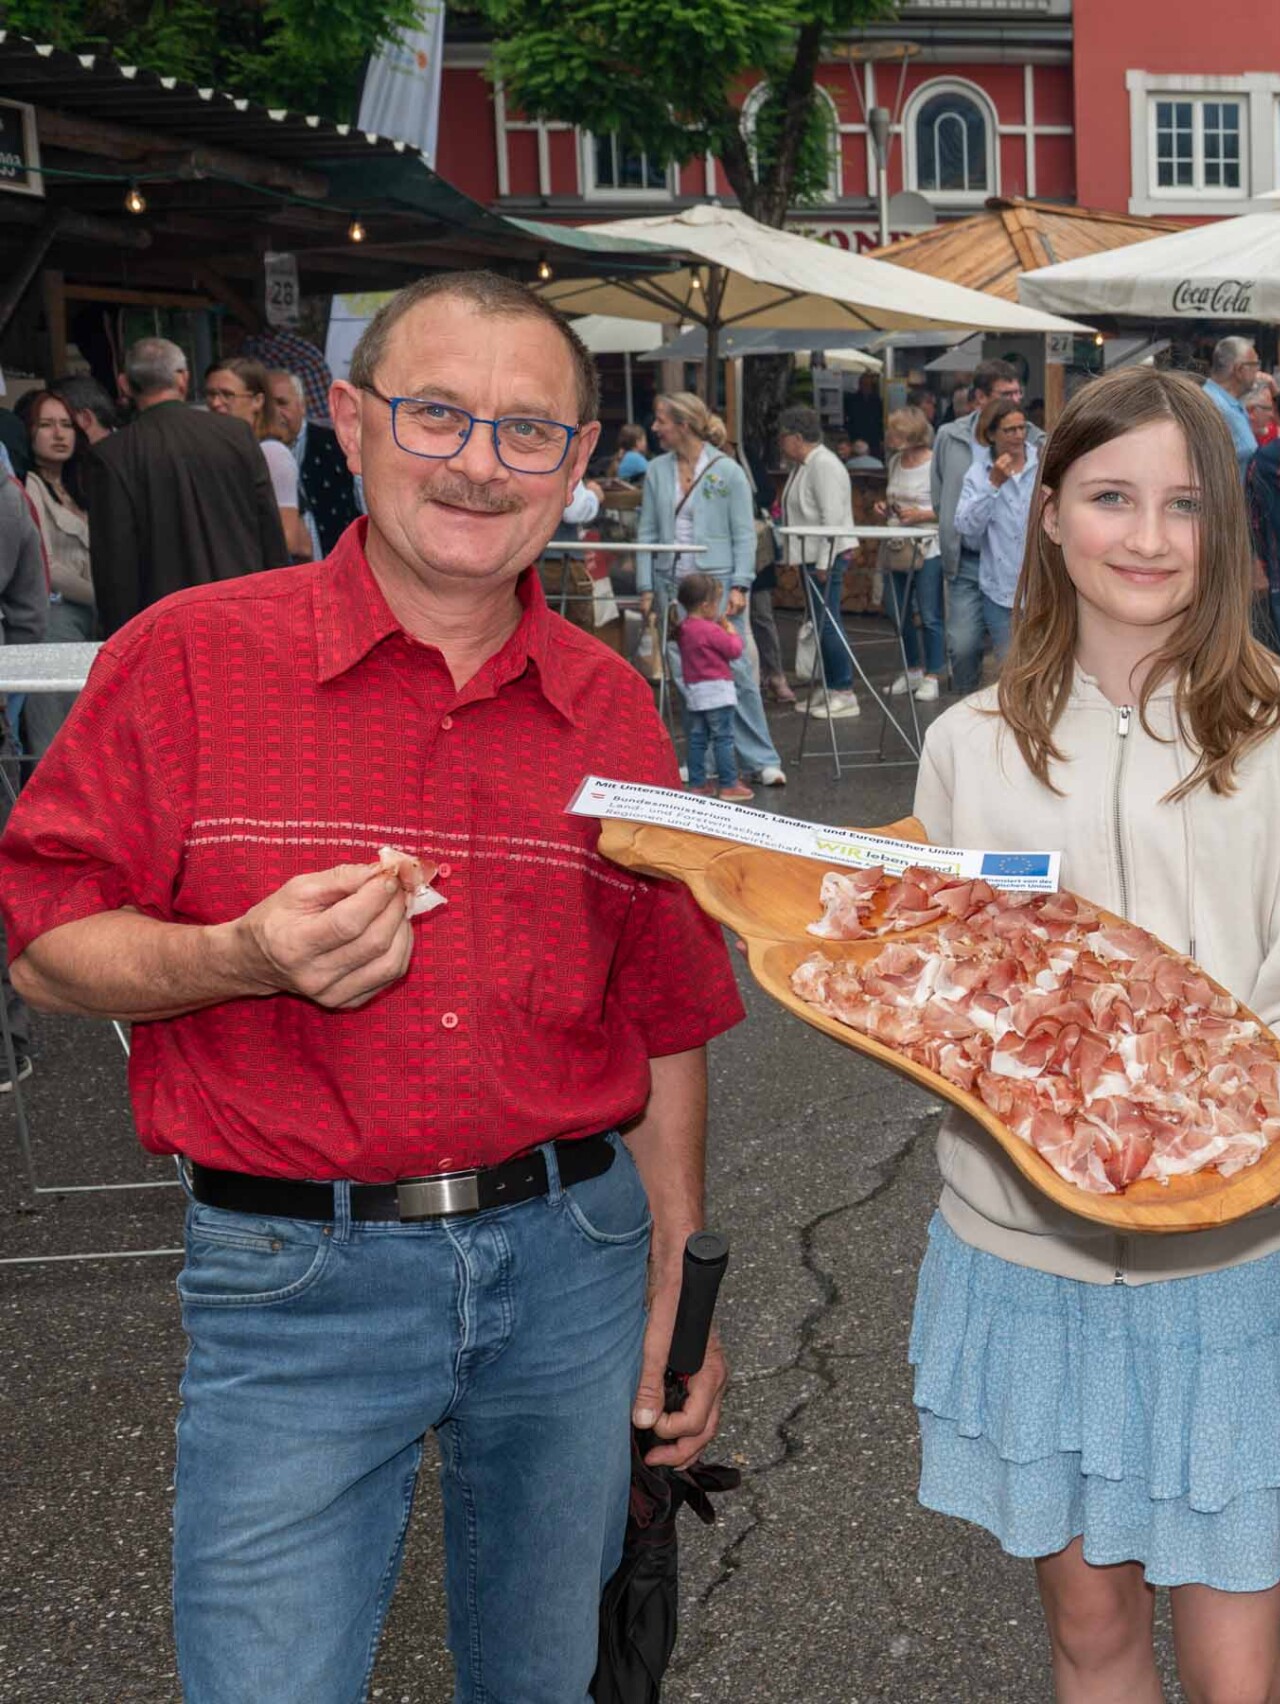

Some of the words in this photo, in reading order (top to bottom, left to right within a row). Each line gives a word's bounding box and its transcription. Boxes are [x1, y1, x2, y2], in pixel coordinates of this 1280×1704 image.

[271, 281, 294, 306] 28
[1172, 279, 1254, 313] Coca-Cola
[1051, 336, 1069, 351] 27
[595, 781, 616, 789] Mit
[620, 783, 707, 805] Unterstützung
[709, 801, 732, 810] von
[735, 807, 768, 820] Bund,
[772, 816, 820, 831] Länder
[823, 828, 846, 836] und
[849, 832, 925, 852] Europäischer
[928, 847, 964, 857] Union
[608, 802, 643, 811] Land-
[613, 795, 731, 821] Bundesministerium
[605, 809, 663, 822] Regionen
[667, 818, 691, 827] und
[695, 823, 803, 853] Wasserwirtschaft
[816, 840, 861, 860] WIR
[866, 851, 910, 866] leben
